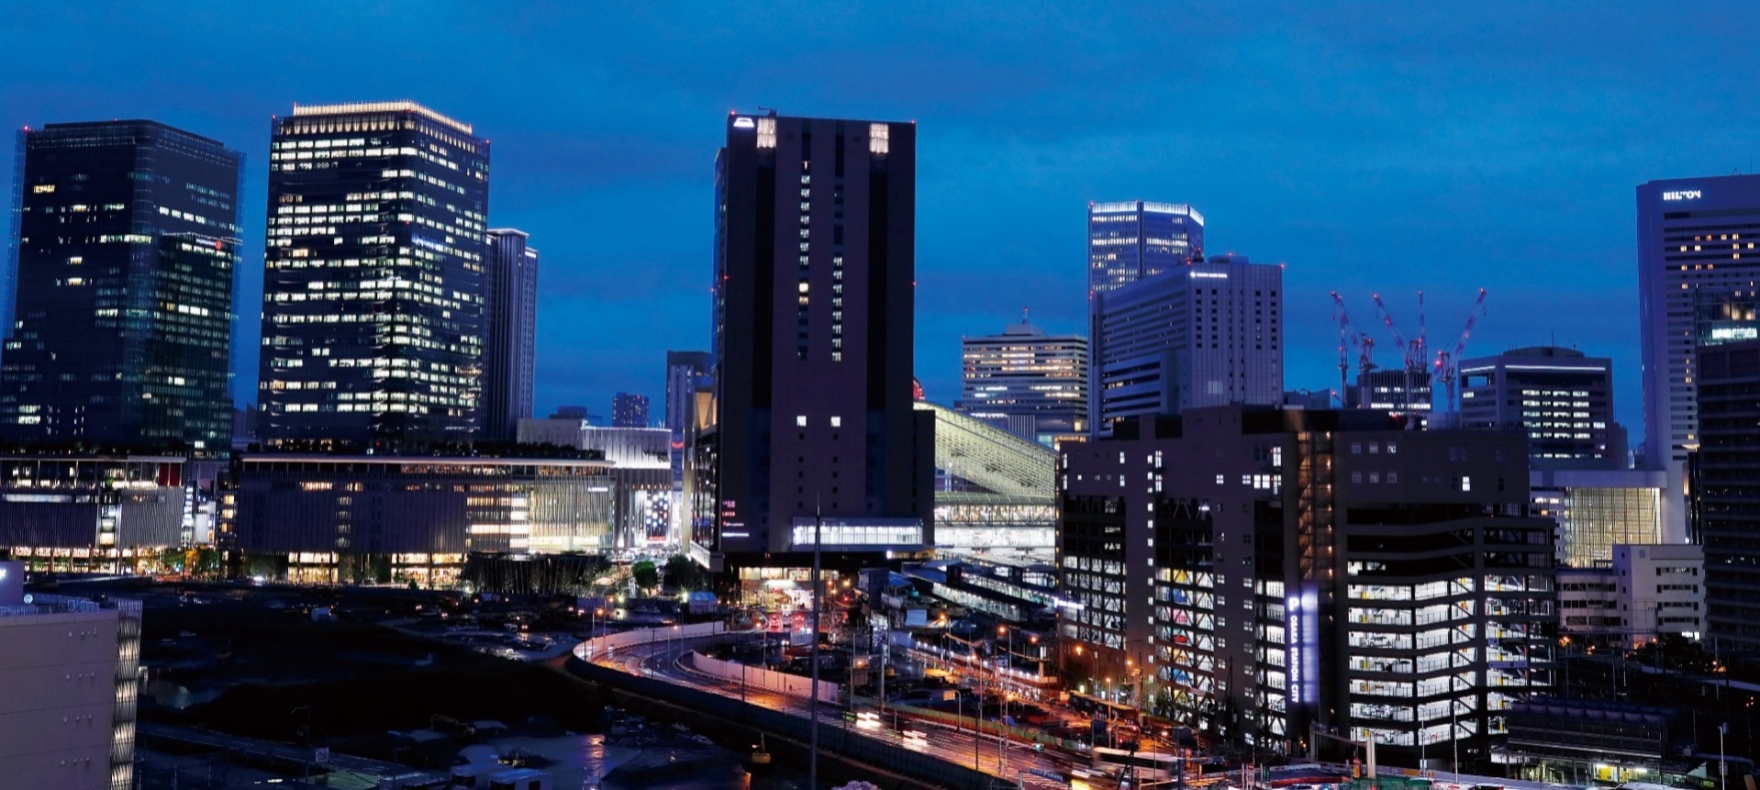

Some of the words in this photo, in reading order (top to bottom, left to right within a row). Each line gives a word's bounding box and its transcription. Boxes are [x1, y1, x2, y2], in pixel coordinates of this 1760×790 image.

[1663, 190, 1701, 200] HILTON
[1288, 597, 1300, 612] P
[1290, 615, 1298, 644] OSAKA
[1291, 647, 1299, 682] STATION
[1291, 684, 1299, 703] CITY
